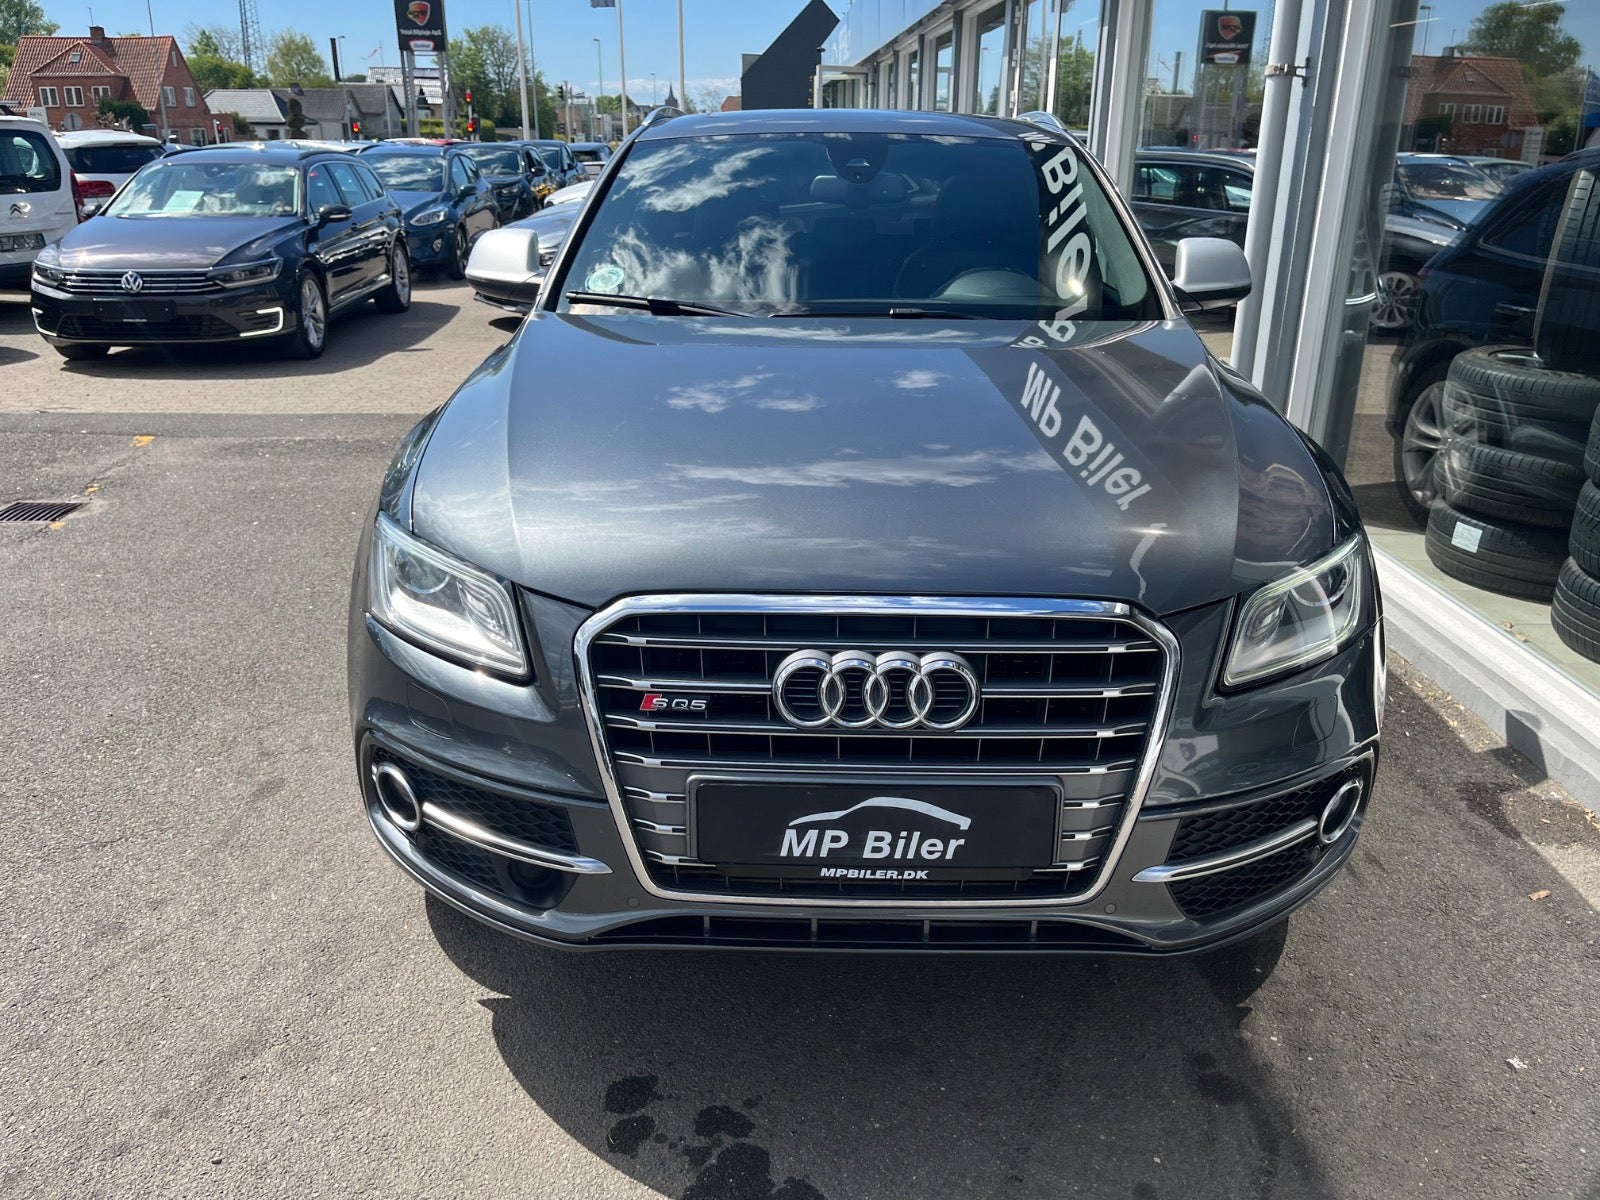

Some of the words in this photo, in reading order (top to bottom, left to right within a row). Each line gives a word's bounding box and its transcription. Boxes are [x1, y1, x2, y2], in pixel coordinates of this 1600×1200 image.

[651, 697, 707, 710] SQ5
[779, 828, 849, 858] MP
[862, 830, 966, 860] Biler
[820, 867, 930, 880] MPBILER.DK
